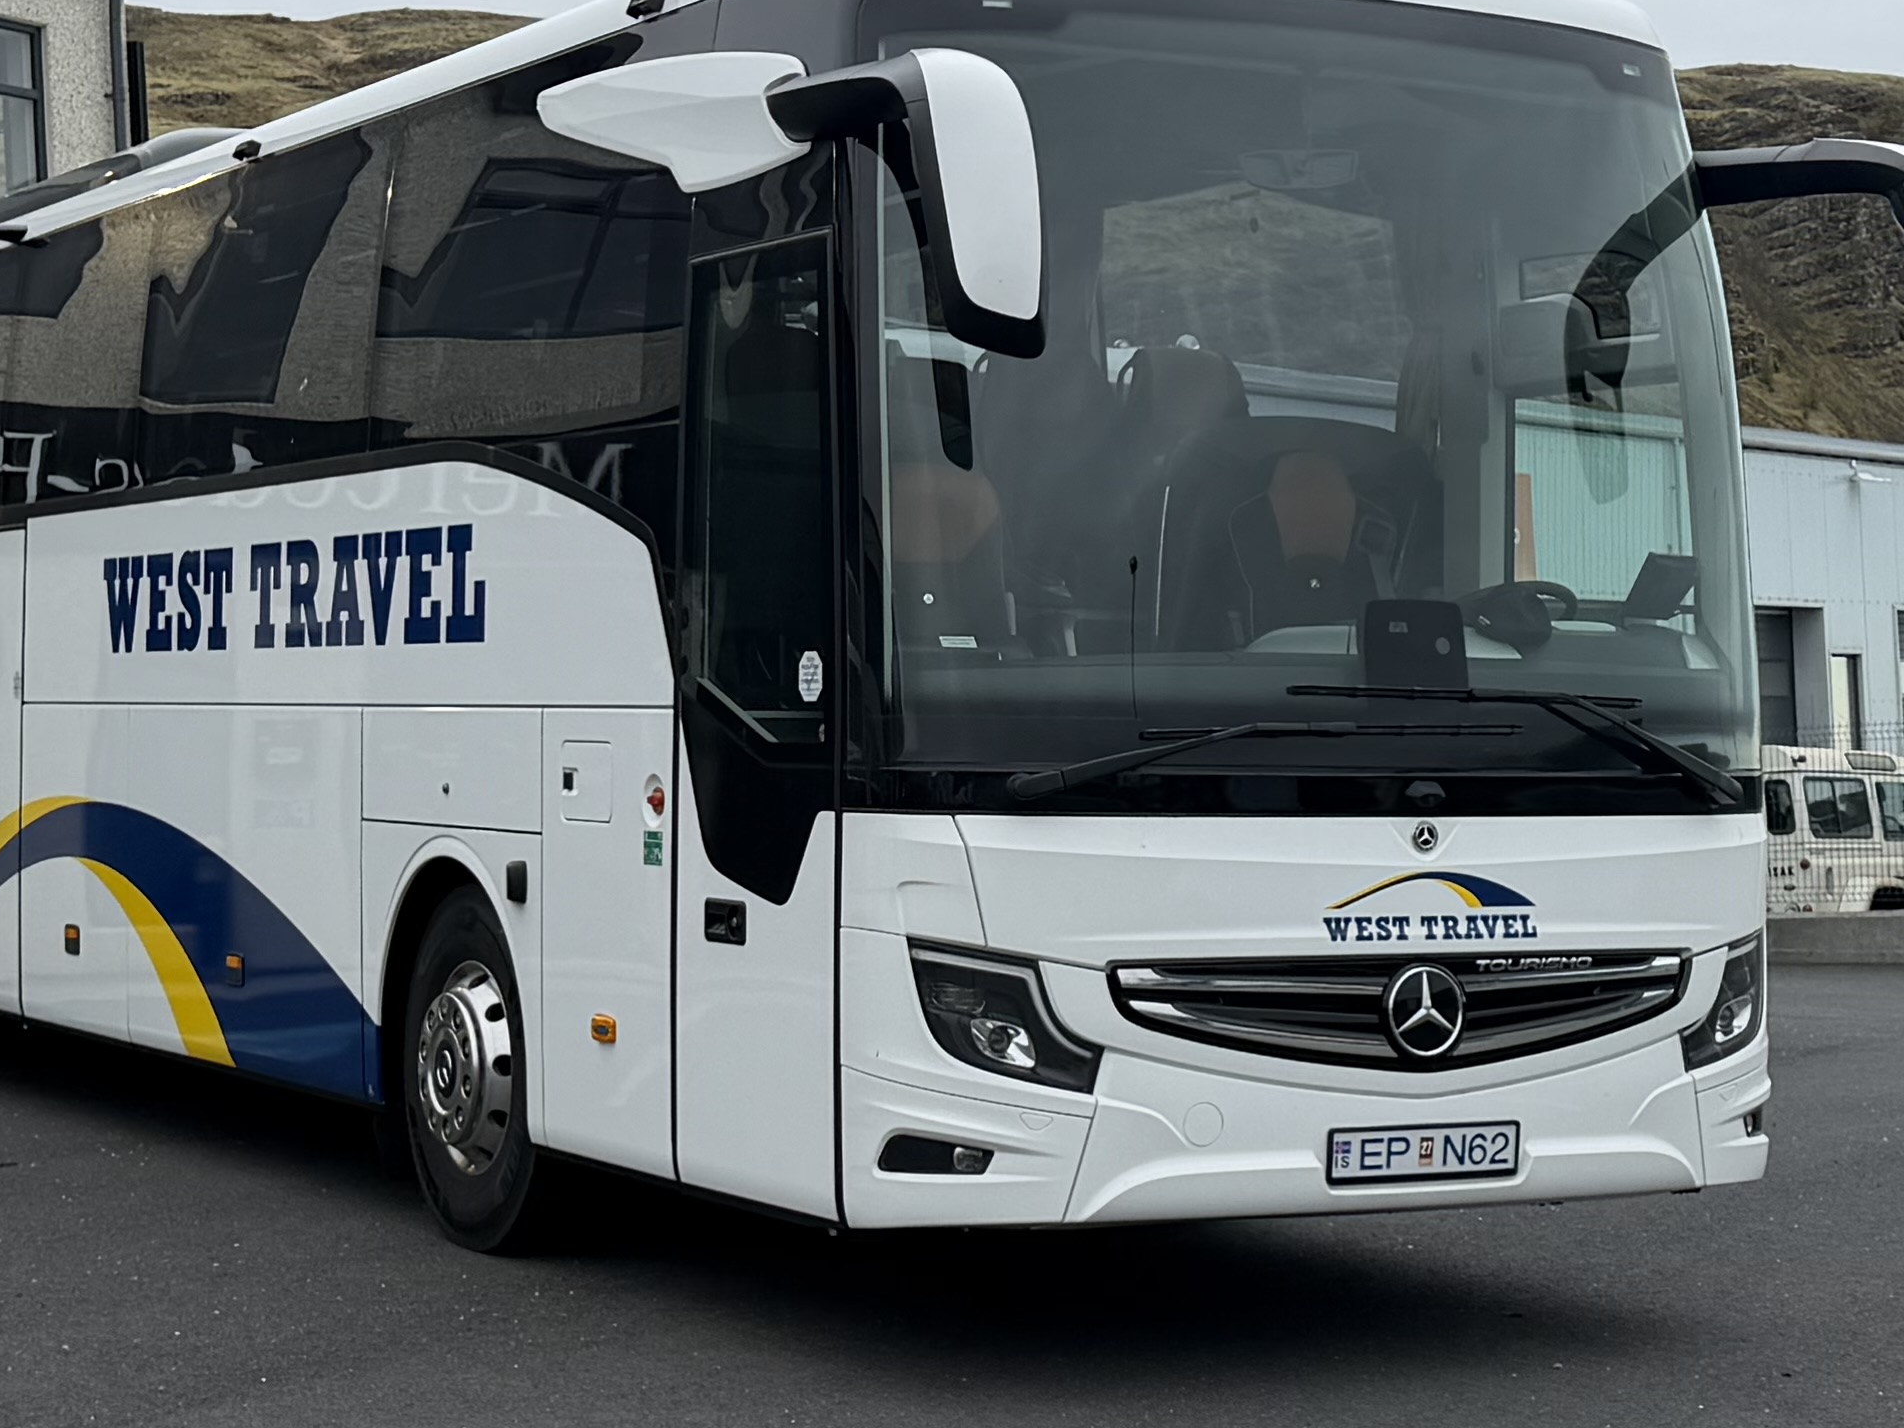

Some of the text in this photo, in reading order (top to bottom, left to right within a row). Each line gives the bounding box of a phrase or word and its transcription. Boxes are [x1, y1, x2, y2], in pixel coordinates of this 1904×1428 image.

[103, 523, 486, 653] WEST TRAVEL
[1322, 914, 1538, 941] WEST TRAVEL
[1476, 956, 1592, 972] TOURISMO
[1360, 1132, 1510, 1170] EP N62
[1421, 1141, 1432, 1155] 27
[1335, 1155, 1349, 1168] IS
